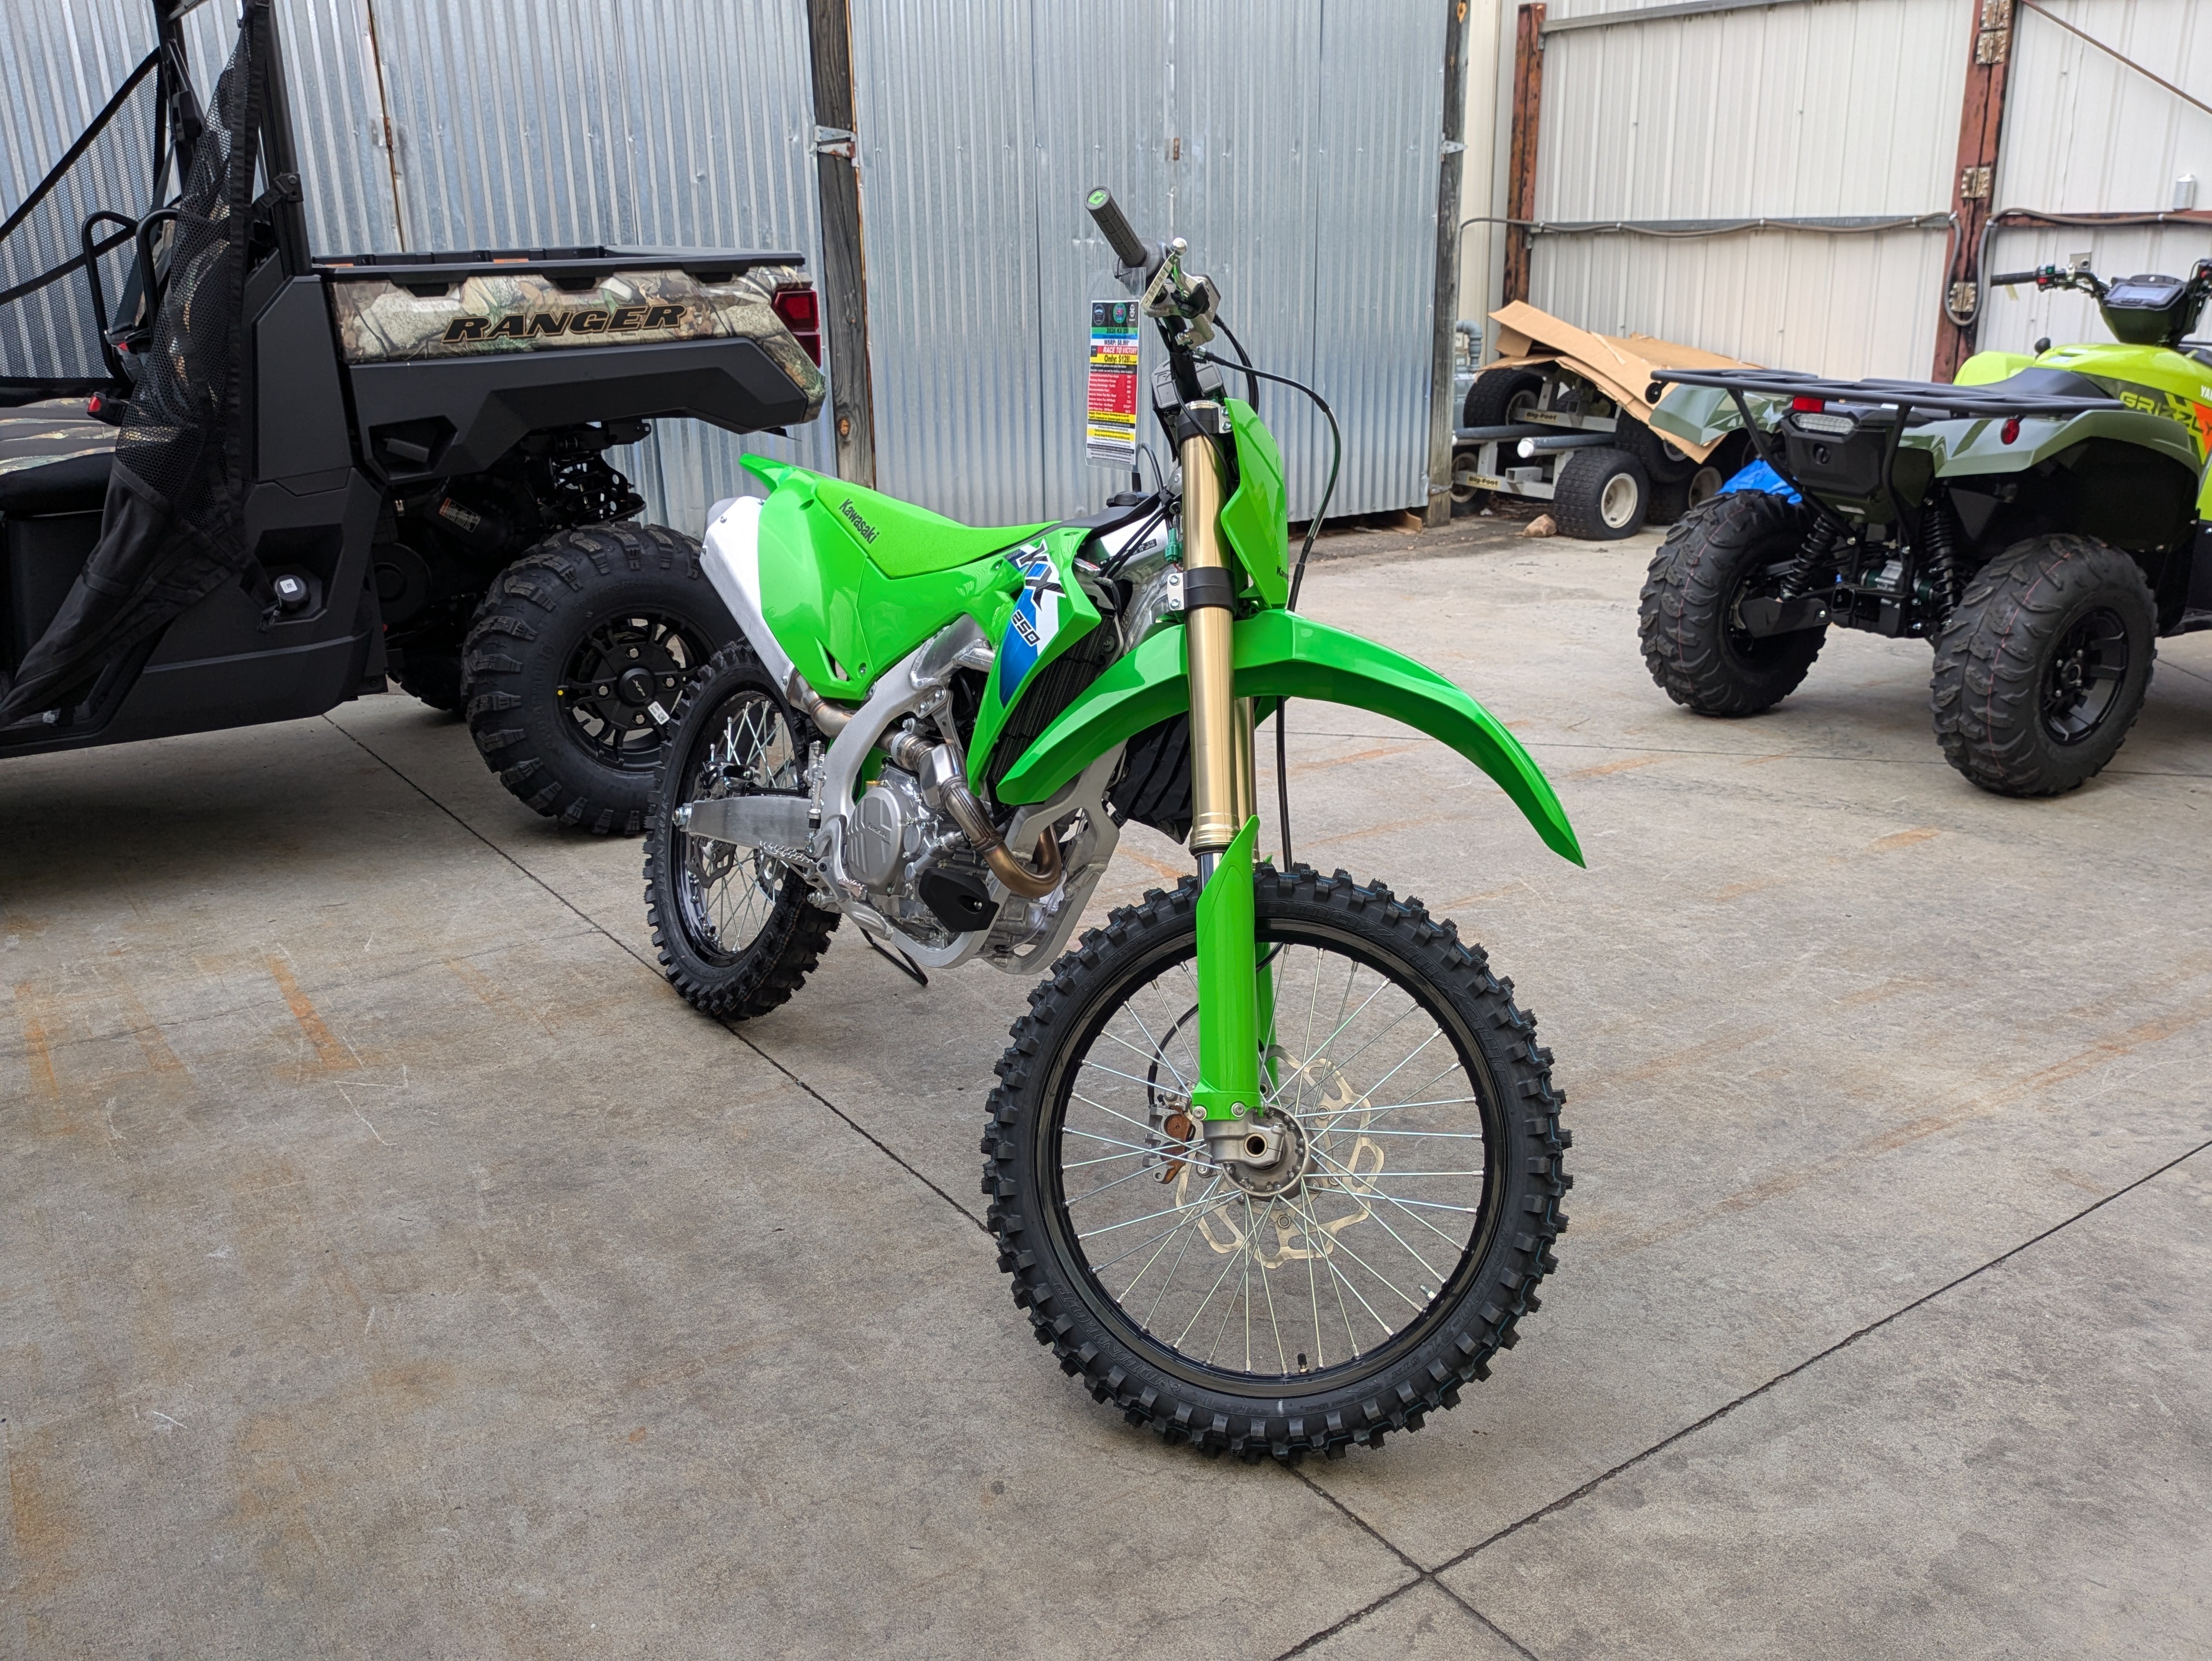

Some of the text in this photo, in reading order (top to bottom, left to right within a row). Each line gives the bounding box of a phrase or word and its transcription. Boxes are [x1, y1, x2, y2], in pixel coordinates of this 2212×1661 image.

[440, 304, 687, 343] RANGER
[1104, 354, 1117, 364] Only:
[2119, 390, 2212, 436] GRIZZLY
[839, 498, 880, 544] Kawasaki
[1018, 541, 1066, 611] KX
[1012, 610, 1041, 646] 250
[632, 679, 645, 696] XP
[1054, 1283, 1164, 1388] DUNLOP
